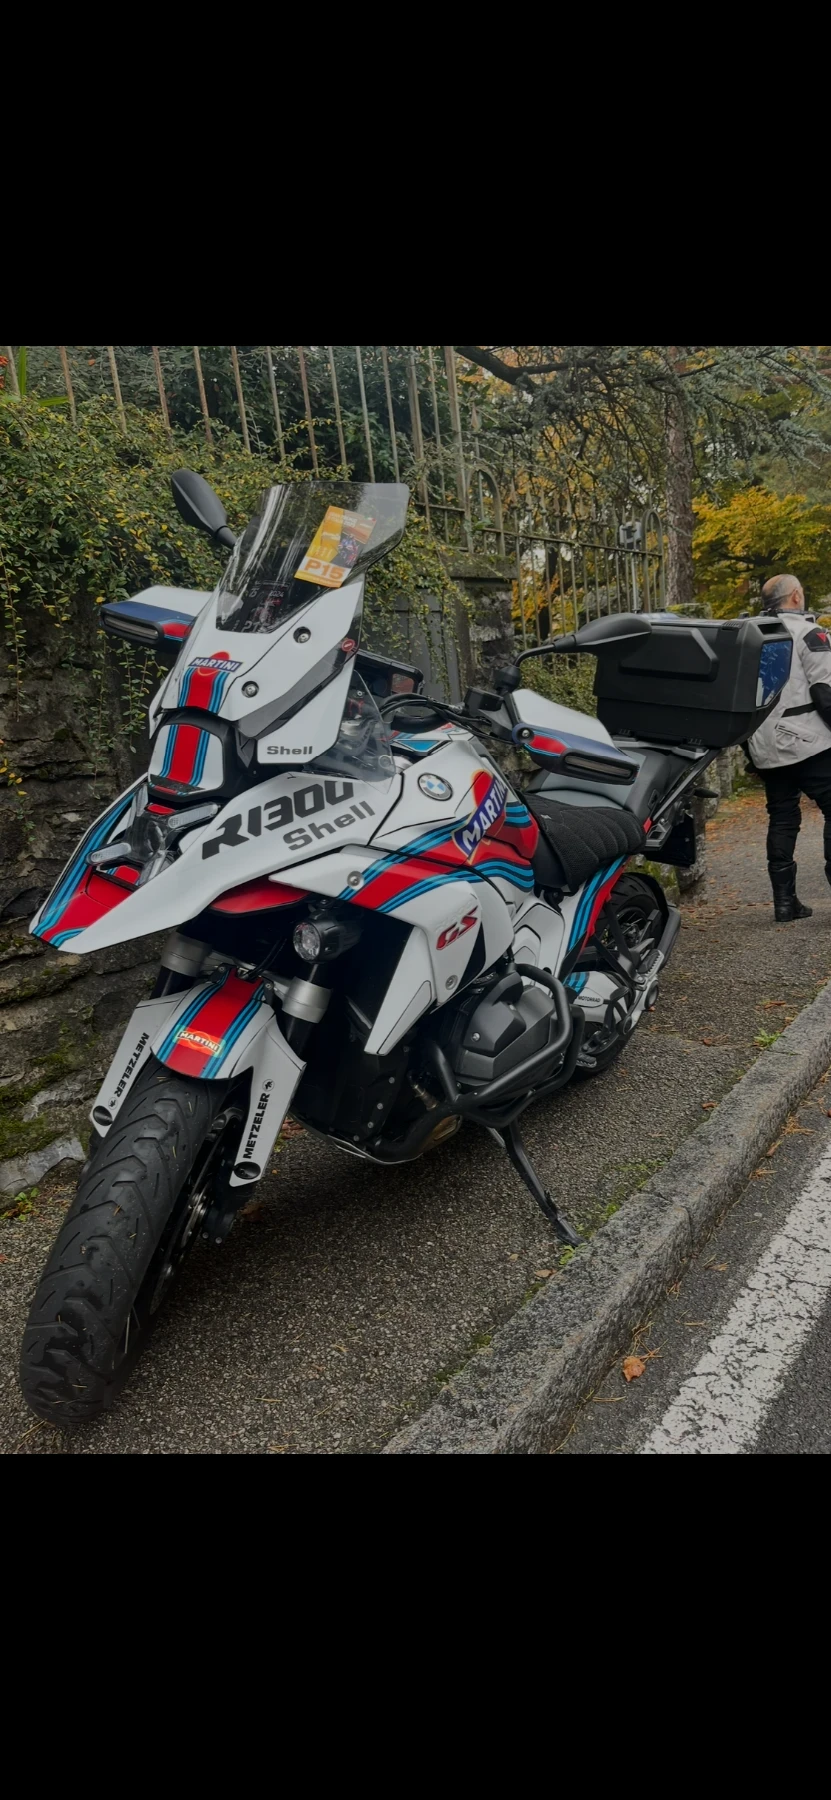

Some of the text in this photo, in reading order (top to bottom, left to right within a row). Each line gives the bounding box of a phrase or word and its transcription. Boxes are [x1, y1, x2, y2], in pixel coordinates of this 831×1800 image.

[304, 559, 346, 579] P15
[191, 658, 240, 671] MARTINI
[266, 745, 313, 756] Shell
[282, 800, 376, 851] Shell
[462, 779, 507, 851] MARTIN
[436, 905, 478, 951] GS
[179, 1031, 221, 1052] MARTINI
[114, 1032, 150, 1098] METZELER
[243, 1092, 271, 1159] METZELER
